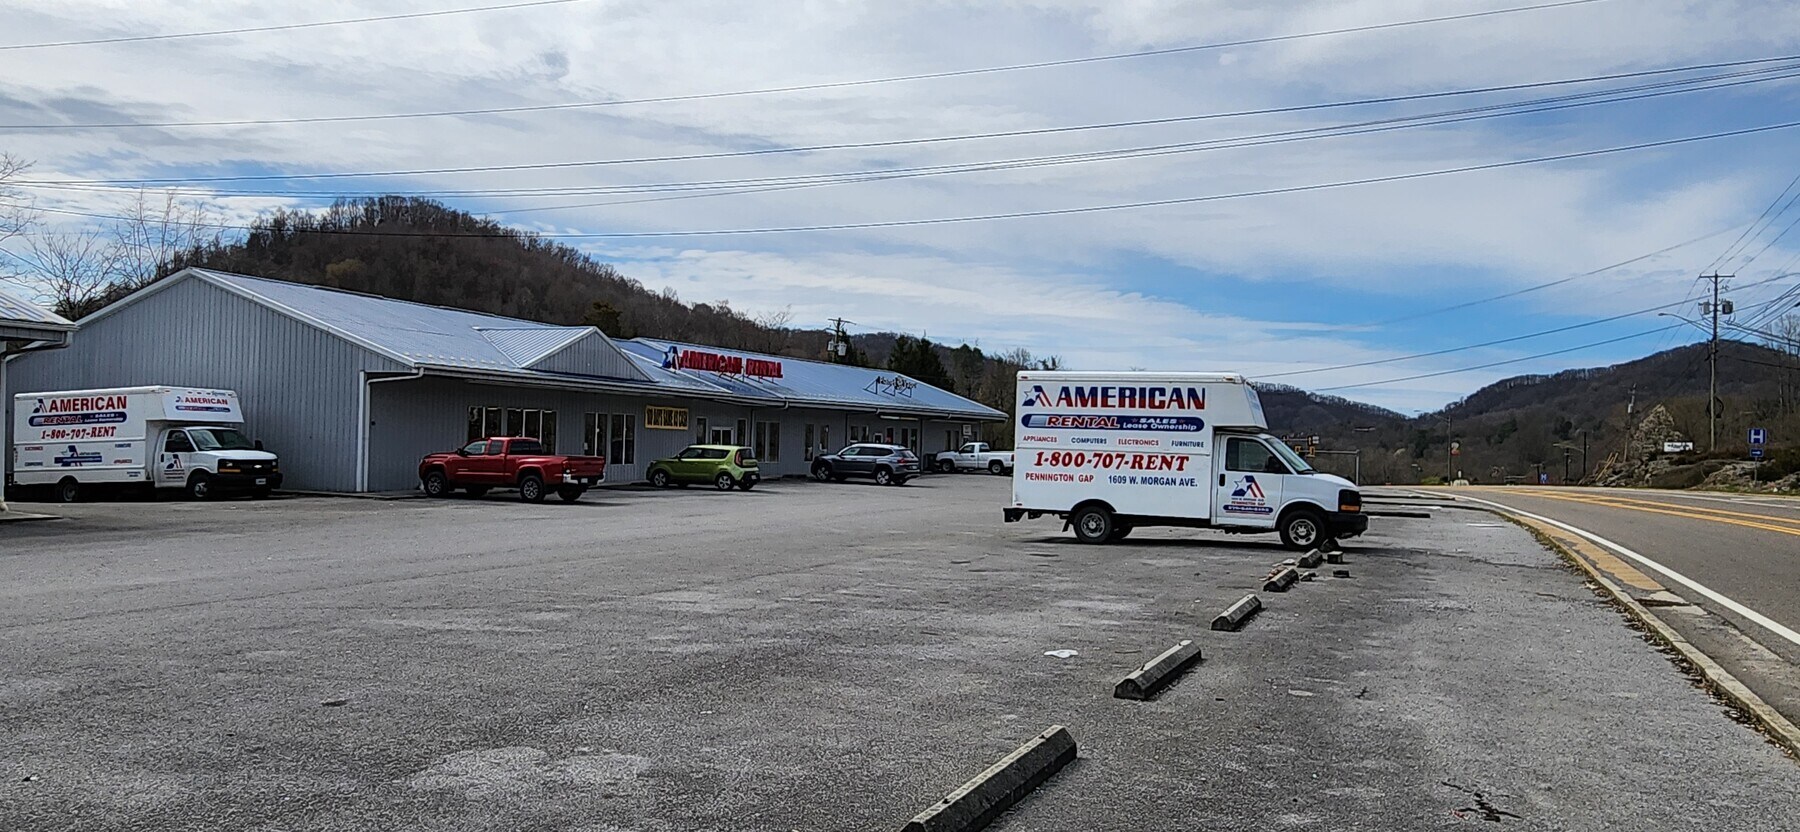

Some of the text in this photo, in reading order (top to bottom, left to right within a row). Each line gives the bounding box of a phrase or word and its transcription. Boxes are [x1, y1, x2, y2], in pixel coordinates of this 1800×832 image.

[680, 350, 743, 374] AMERICAN
[185, 397, 228, 405] AMERICAN
[1055, 386, 1206, 410] AMERICAN
[49, 396, 127, 413] AMERICAN
[42, 415, 83, 425] RENTAL
[1046, 416, 1121, 428] RENTAL
[1150, 422, 1197, 431] Ownership
[41, 426, 117, 440] 1-800-707-RENT
[1023, 435, 1058, 443] APPLIANCES
[1750, 429, 1764, 443] H
[1118, 438, 1159, 446] ELECTRONICS
[1171, 440, 1205, 448] FURNITURE
[1033, 451, 1190, 471] 1-800-707-RENT
[1025, 472, 1094, 483] PENNINGTON GAP
[1108, 475, 1198, 487] 1609 W. MORGAN AVE.
